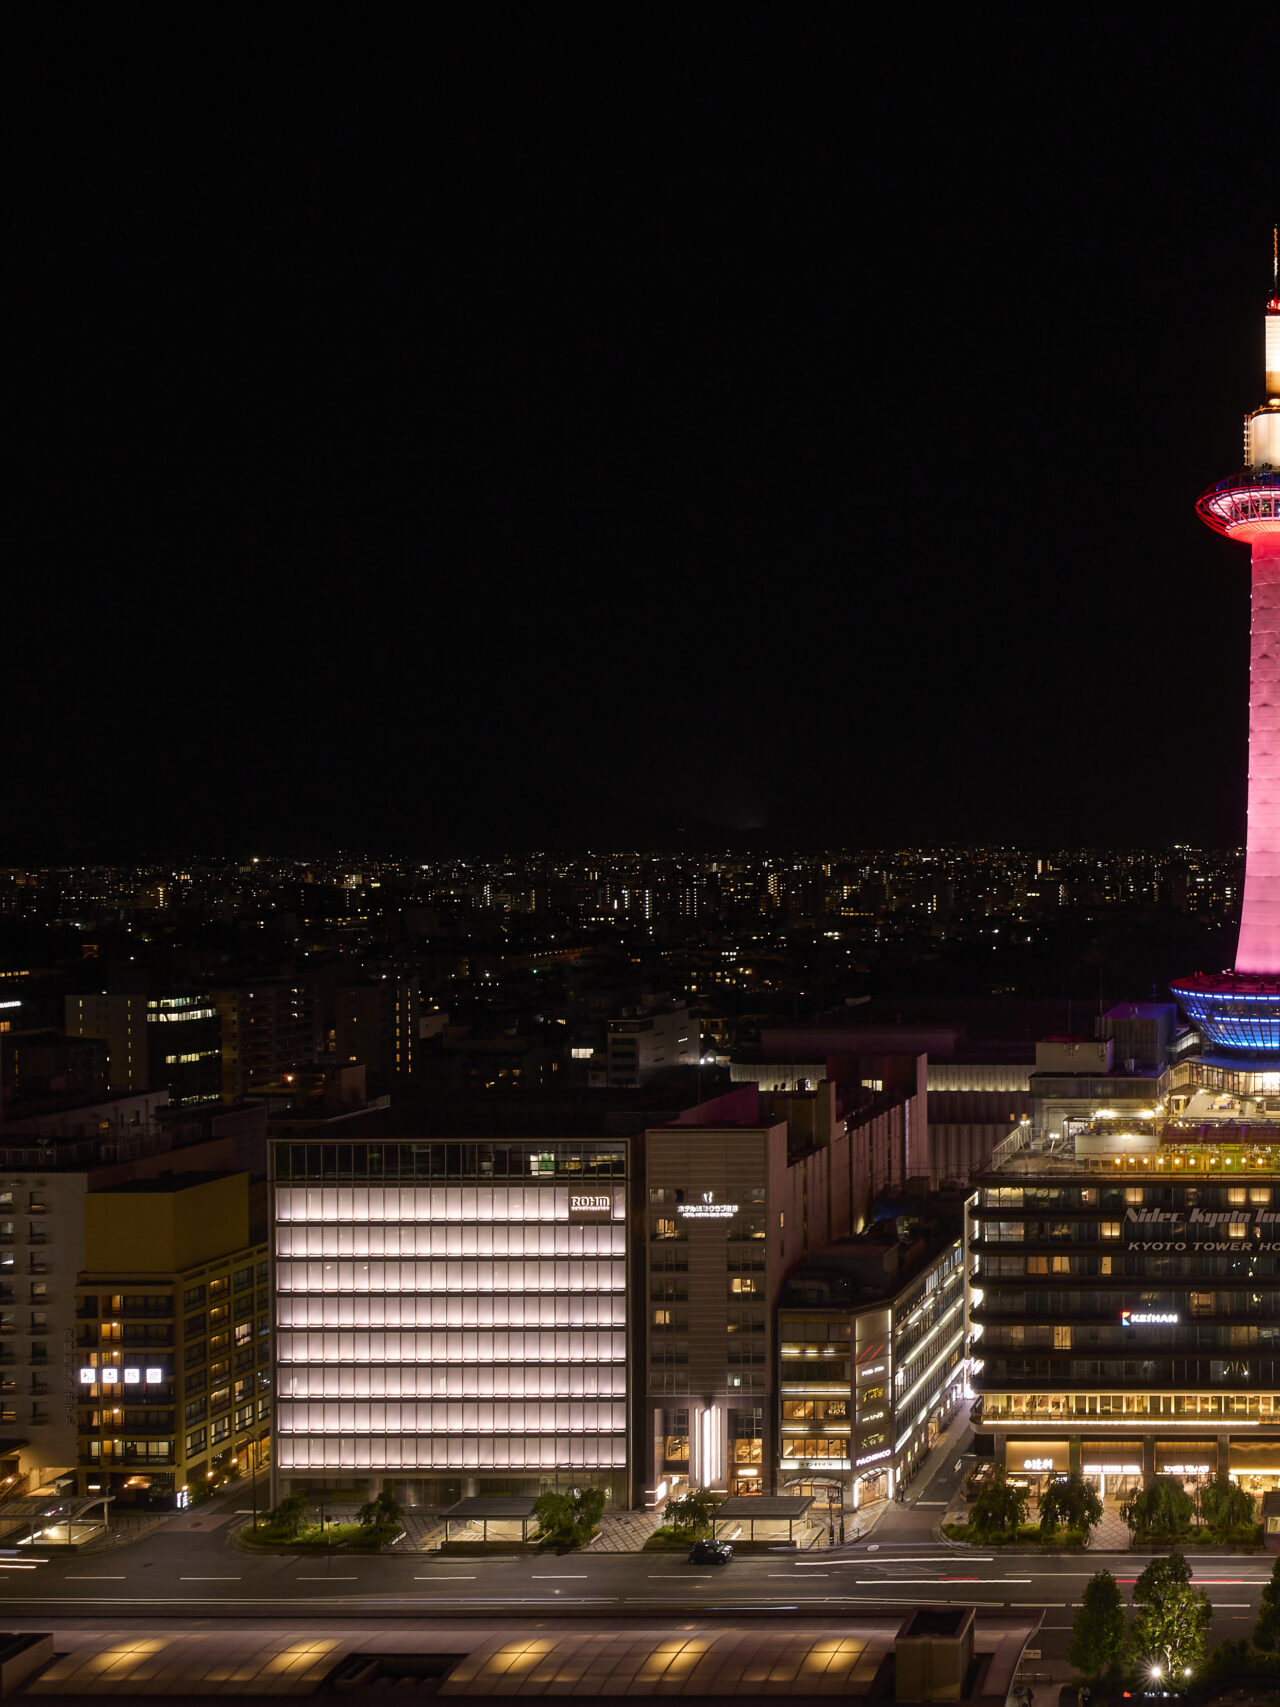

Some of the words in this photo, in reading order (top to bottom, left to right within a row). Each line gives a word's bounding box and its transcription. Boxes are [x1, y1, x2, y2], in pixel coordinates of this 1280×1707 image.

[571, 1196, 610, 1206] ROHM
[1124, 1208, 1184, 1223] Nidec
[1189, 1208, 1250, 1228] Kyoto
[1128, 1242, 1187, 1251] KYOTO
[1193, 1242, 1253, 1251] TOWER
[1131, 1314, 1178, 1323] KEIHAN
